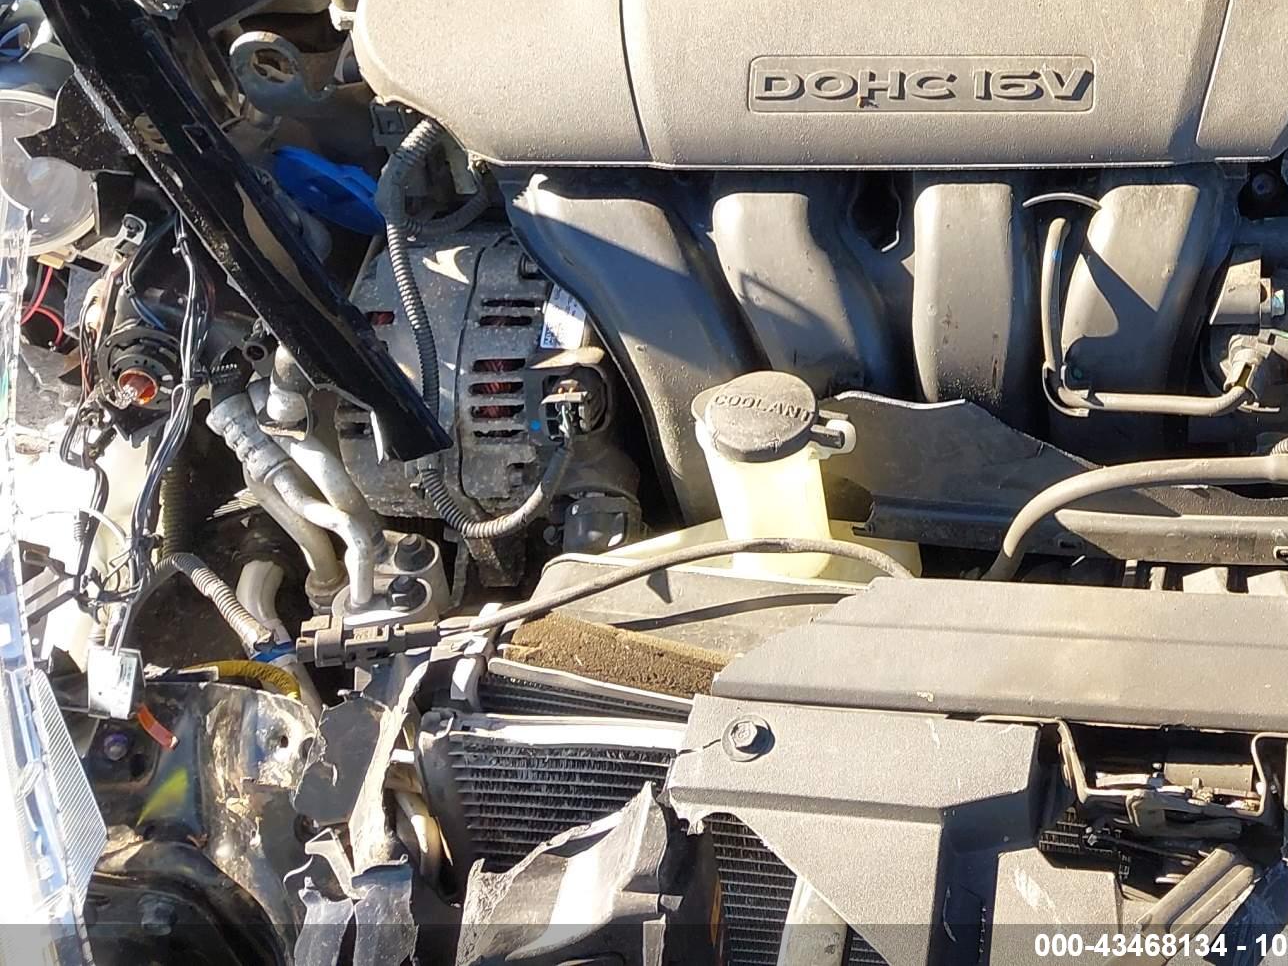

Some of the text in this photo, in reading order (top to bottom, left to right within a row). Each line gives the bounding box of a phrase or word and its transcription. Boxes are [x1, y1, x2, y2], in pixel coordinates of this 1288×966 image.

[754, 70, 1095, 101] DOHC 16V
[714, 393, 814, 422] COOLANT
